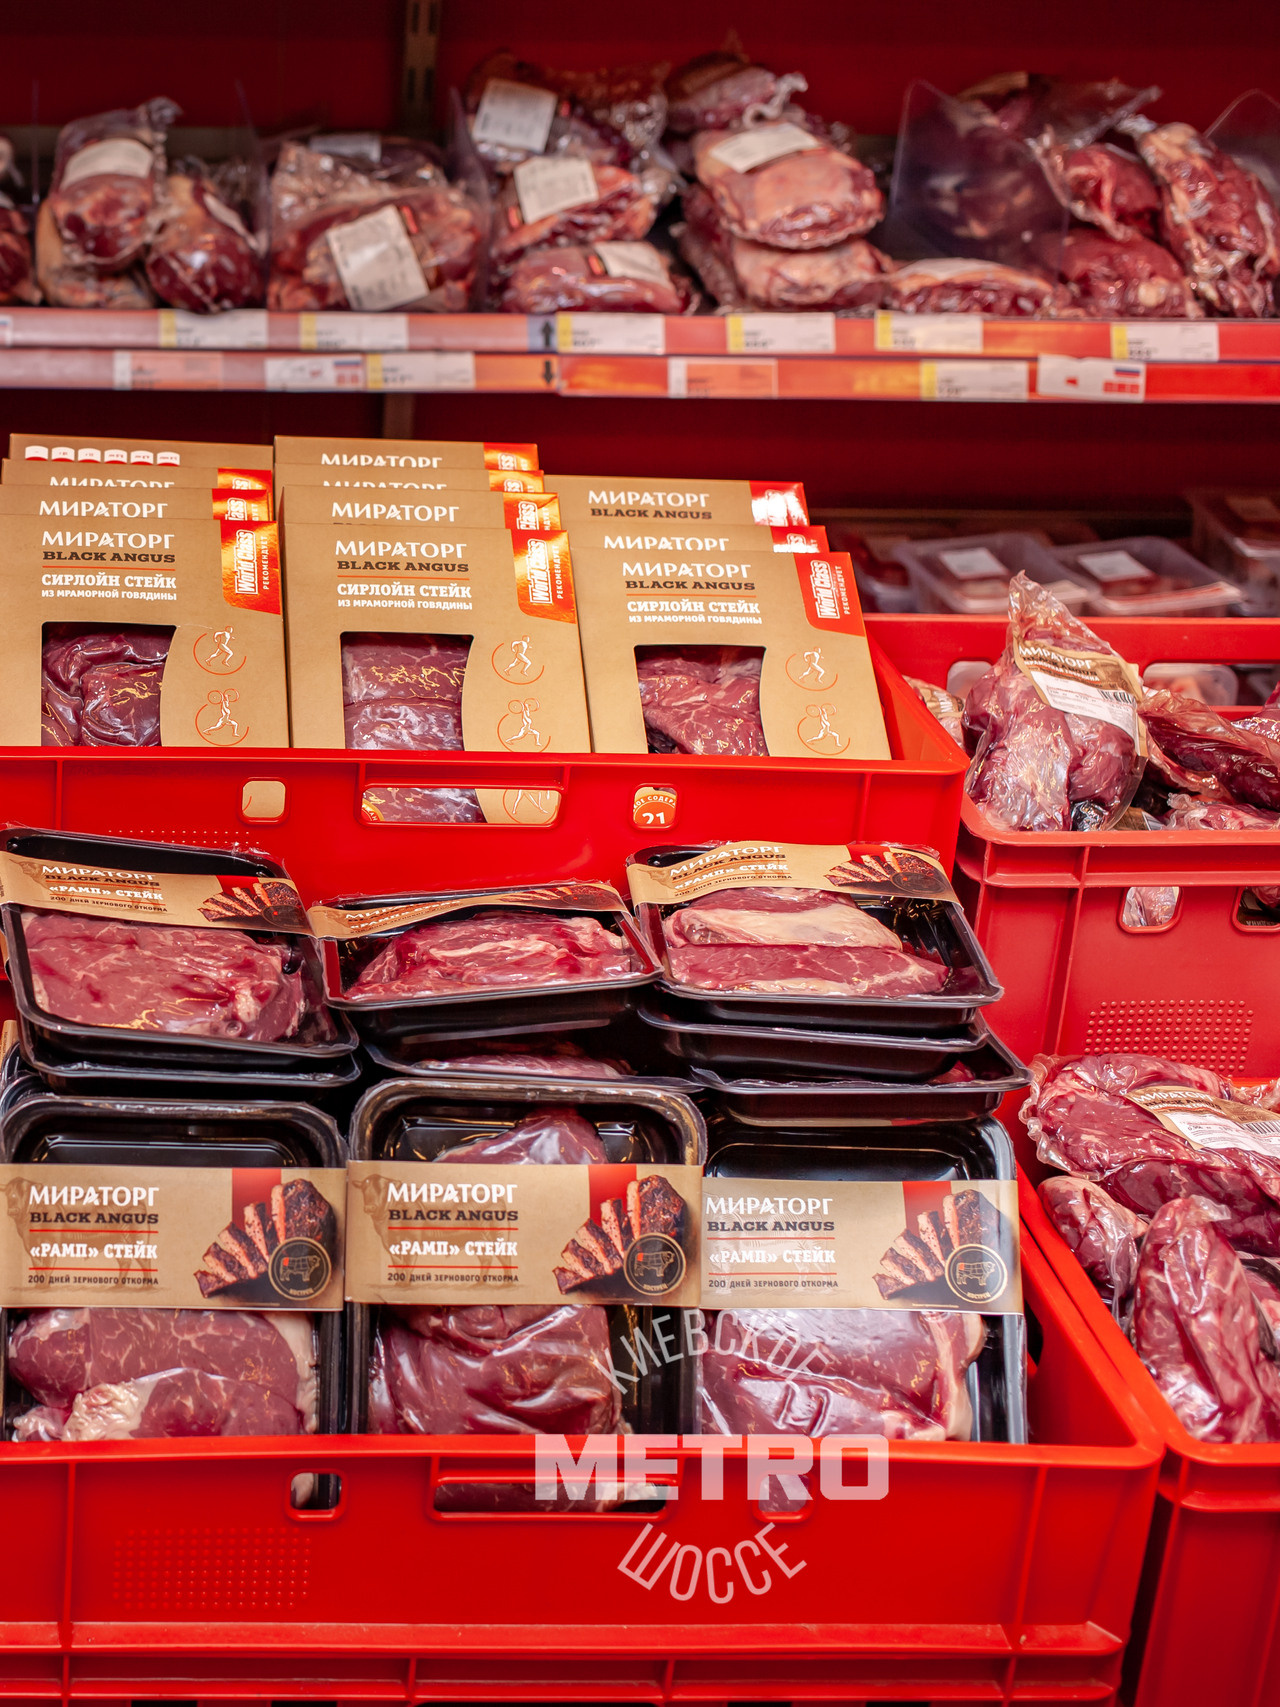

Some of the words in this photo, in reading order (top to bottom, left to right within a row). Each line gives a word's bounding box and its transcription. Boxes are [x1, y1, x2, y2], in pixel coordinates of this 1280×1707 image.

[588, 490, 710, 508] МИРАТОРГ
[39, 501, 168, 518] МИРАТОРГ
[332, 502, 459, 522] МИРАТОРГ
[590, 508, 648, 518] BLACK
[653, 510, 712, 520] ANGUS
[42, 531, 175, 549] МИРАТОРГ
[237, 531, 253, 560] Class
[604, 536, 729, 551] МИРАТОРГ
[43, 551, 107, 561] BLACK
[110, 553, 175, 563] ANGUS
[335, 540, 466, 558] МИРАТОРГ
[261, 536, 269, 589] РЕКОМЕНДУЕТ
[337, 561, 400, 571] BLACK
[404, 563, 469, 572] ANGUS
[622, 562, 751, 578] МИРАТОРГ
[42, 572, 120, 587] СИРЛОЙН
[124, 573, 176, 588] СТЕЙК
[238, 562, 255, 591] World
[552, 546, 563, 599] РЕКОМЕНДУЕТ
[813, 562, 831, 588] Class
[337, 581, 415, 596] СИРЛОЙН
[419, 584, 472, 598] СТЕЙК
[531, 569, 550, 601] World
[626, 580, 688, 589] BLACK
[692, 582, 756, 590] ANGUS
[57, 589, 119, 599] МРАМОРНОЙ
[121, 591, 176, 601] ГОВЯДИНЫ
[816, 588, 836, 616] World
[338, 599, 350, 607] ИЗ
[353, 599, 415, 609] МРАМОРНОЙ
[417, 601, 472, 610] ГОВЯДИНЫ
[627, 599, 704, 612] СИРЛОЙН
[709, 600, 760, 614] СТЕЙК
[644, 614, 705, 623] МРАМОРНОЙ
[708, 616, 762, 624] ГОВЯДИНЫ
[42, 865, 156, 881] МИРАТОРГ
[49, 885, 112, 895] «РАМП»
[115, 889, 164, 900] СТЕЙК
[29, 1186, 160, 1206] МИРАТОРГ
[388, 1183, 518, 1204] МИРАТОРГ
[705, 1197, 833, 1215] МИРАТОРГ
[30, 1212, 91, 1223] BLACK
[95, 1213, 159, 1224] ANGUS
[389, 1210, 453, 1221] BLACK
[455, 1210, 518, 1221] ANGUS
[707, 1221, 768, 1232] BLACK
[772, 1221, 834, 1231] ANGUS
[30, 1243, 99, 1258] «РАМП»
[103, 1242, 157, 1259] СТЕЙК
[389, 1242, 460, 1256] «РАМП»
[465, 1240, 518, 1256] СТЕЙК
[709, 1250, 777, 1264] «РАМП»
[782, 1247, 836, 1263] СТЕЙК
[28, 1275, 45, 1284] 200
[48, 1275, 70, 1285] ДНЕЙ
[73, 1276, 119, 1284] ЗЕРНОВОГО
[121, 1277, 159, 1285] ОТКОРМА
[388, 1272, 405, 1282] 200
[409, 1273, 431, 1283] ДНЕЙ
[434, 1274, 480, 1282] ЗЕРНОВОГО
[483, 1274, 519, 1282] ОТКОРМА
[708, 1280, 726, 1288] 200
[729, 1279, 751, 1289] ДНЕЙ
[753, 1280, 799, 1288] ЗЕРНОВОГО
[801, 1280, 838, 1288] ОТКОРМА
